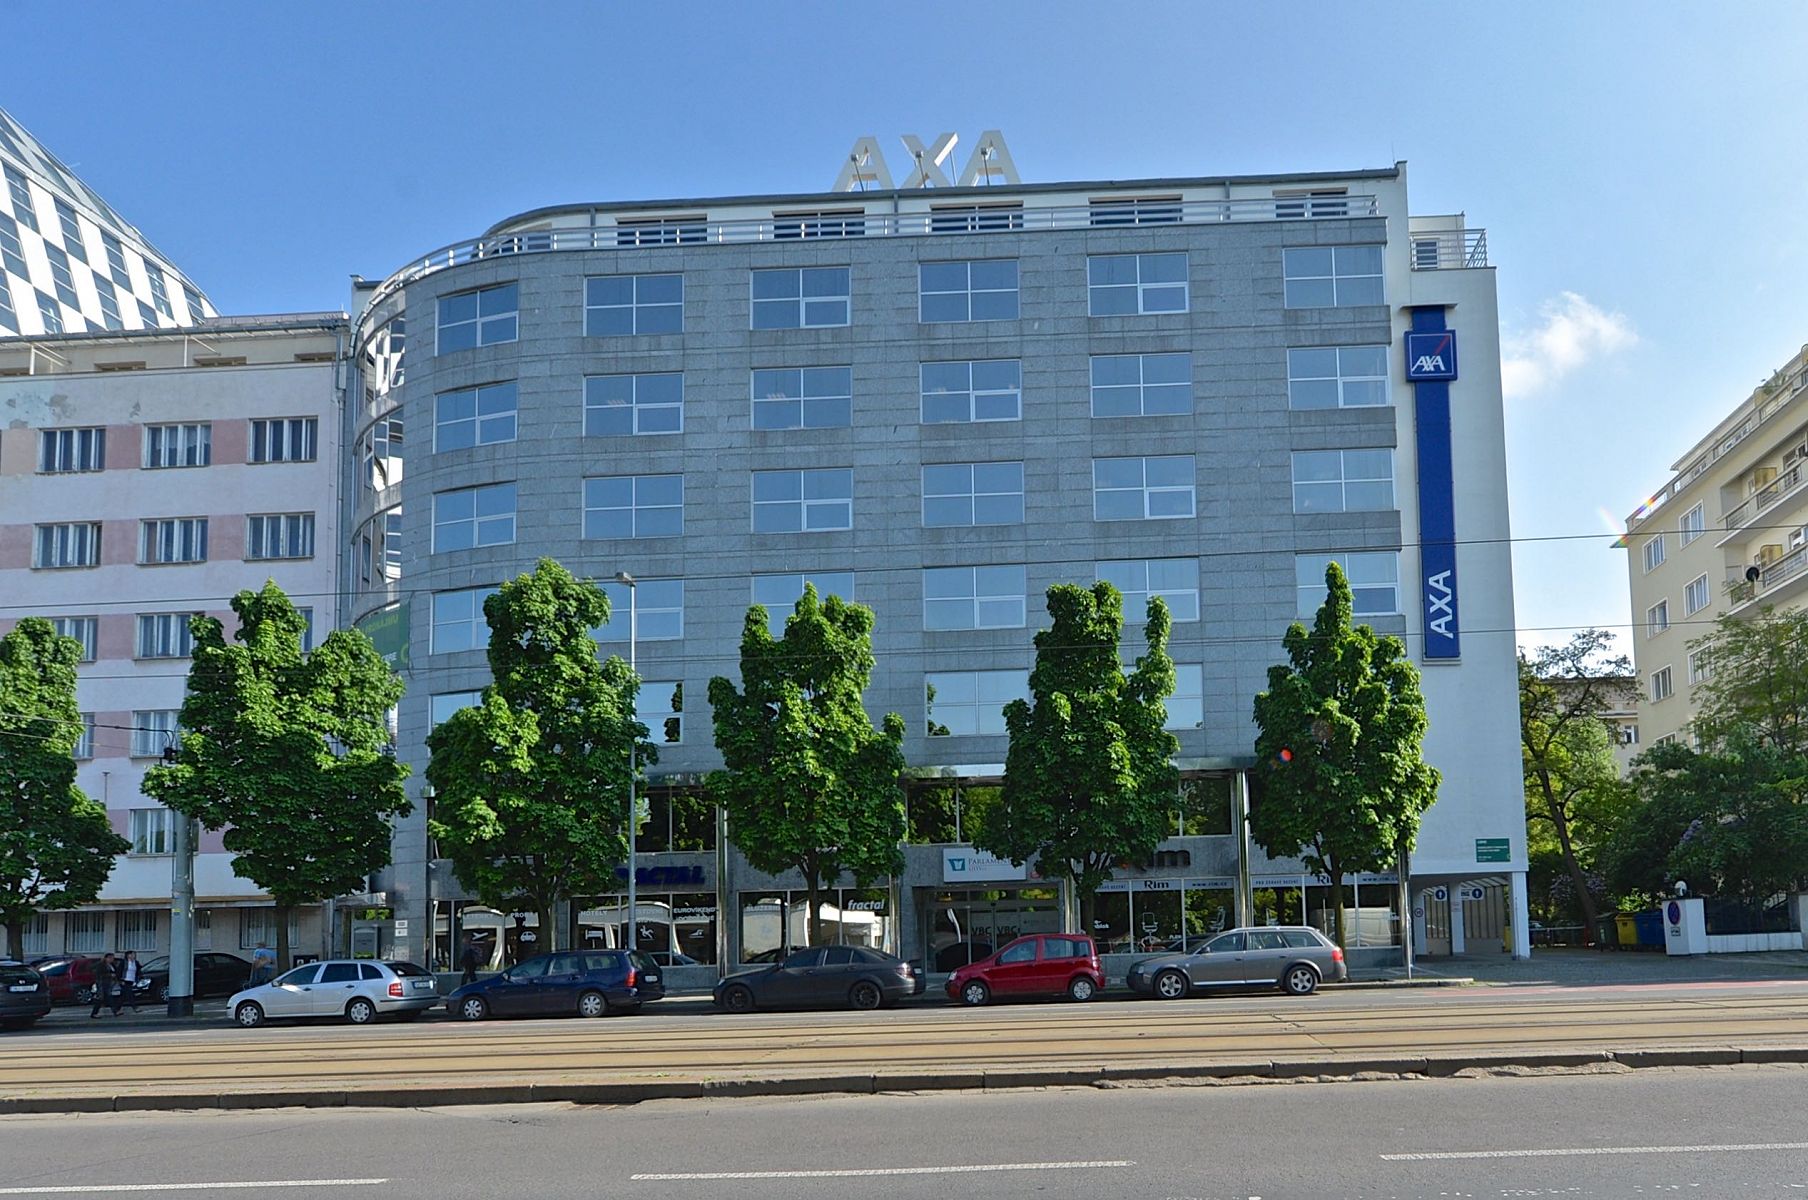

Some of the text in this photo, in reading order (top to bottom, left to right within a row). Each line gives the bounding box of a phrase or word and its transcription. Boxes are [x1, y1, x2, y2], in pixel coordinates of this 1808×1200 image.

[832, 130, 1022, 192] AXA
[1411, 355, 1445, 372] AXA
[1428, 569, 1454, 639] AXA
[1144, 880, 1170, 890] Rim
[1315, 875, 1332, 885] Ri
[847, 899, 885, 911] fractal
